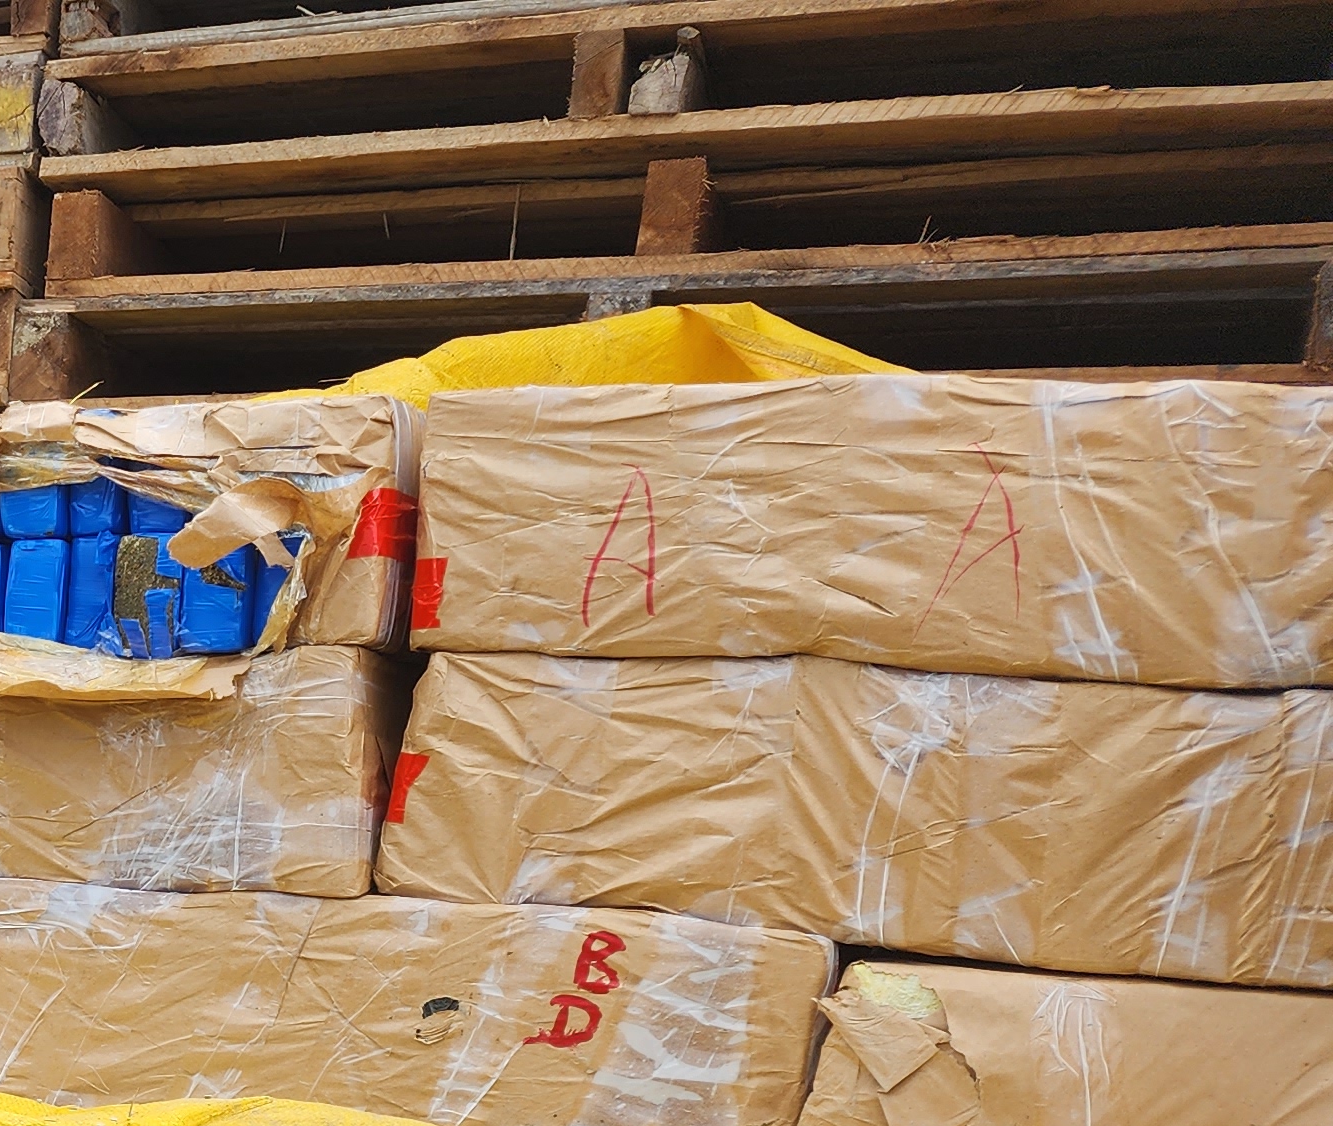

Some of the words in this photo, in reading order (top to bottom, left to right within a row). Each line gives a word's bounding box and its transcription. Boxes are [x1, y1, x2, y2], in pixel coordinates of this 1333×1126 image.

[582, 463, 656, 627] A
[912, 441, 1025, 645] A
[573, 930, 627, 994] B
[522, 994, 604, 1048] D
